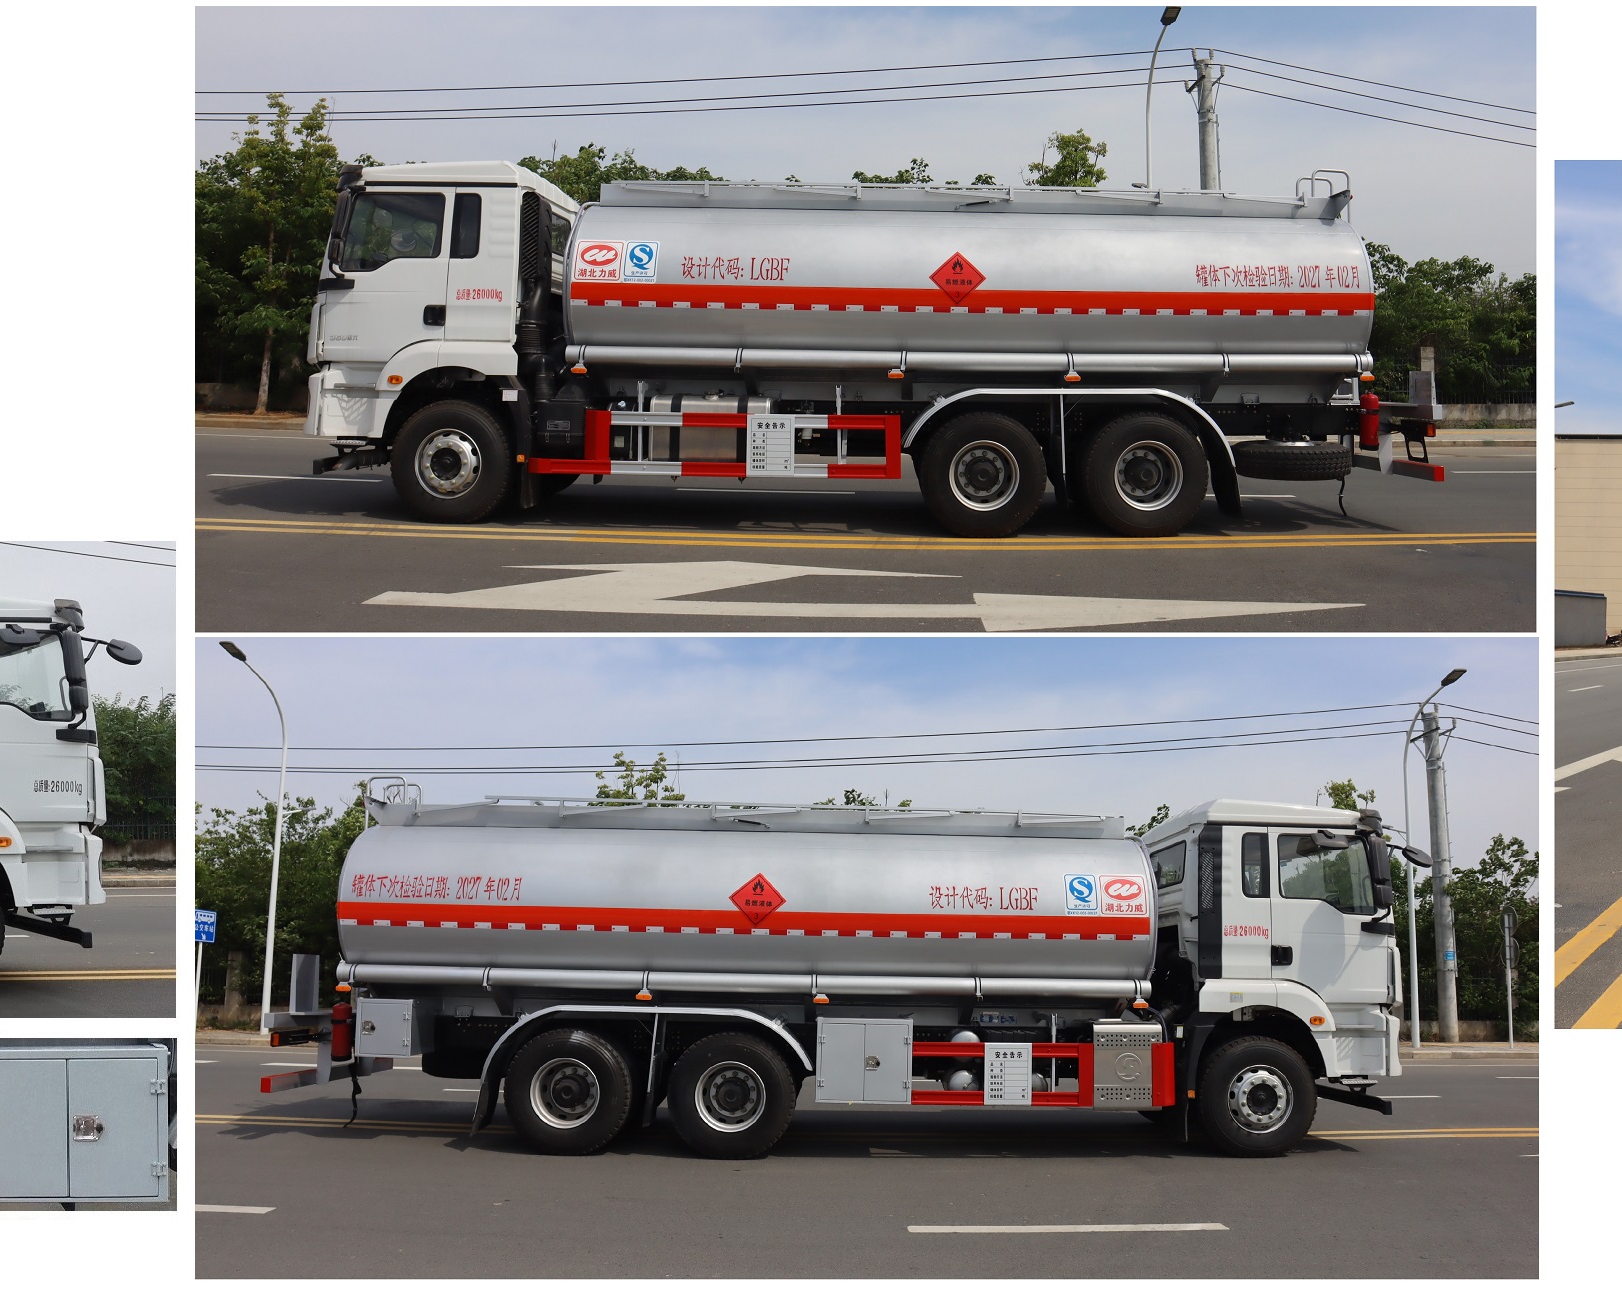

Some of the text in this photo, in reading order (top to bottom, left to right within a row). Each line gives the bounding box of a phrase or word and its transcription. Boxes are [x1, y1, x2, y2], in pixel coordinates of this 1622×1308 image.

[577, 268, 617, 278] 湖北力威
[750, 257, 790, 281] LGBF
[1297, 265, 1320, 288] 2027
[456, 876, 482, 900] 2027
[999, 887, 1039, 911] LGBF
[745, 899, 773, 907] 易燃液体
[1105, 903, 1144, 913] 湖北力威
